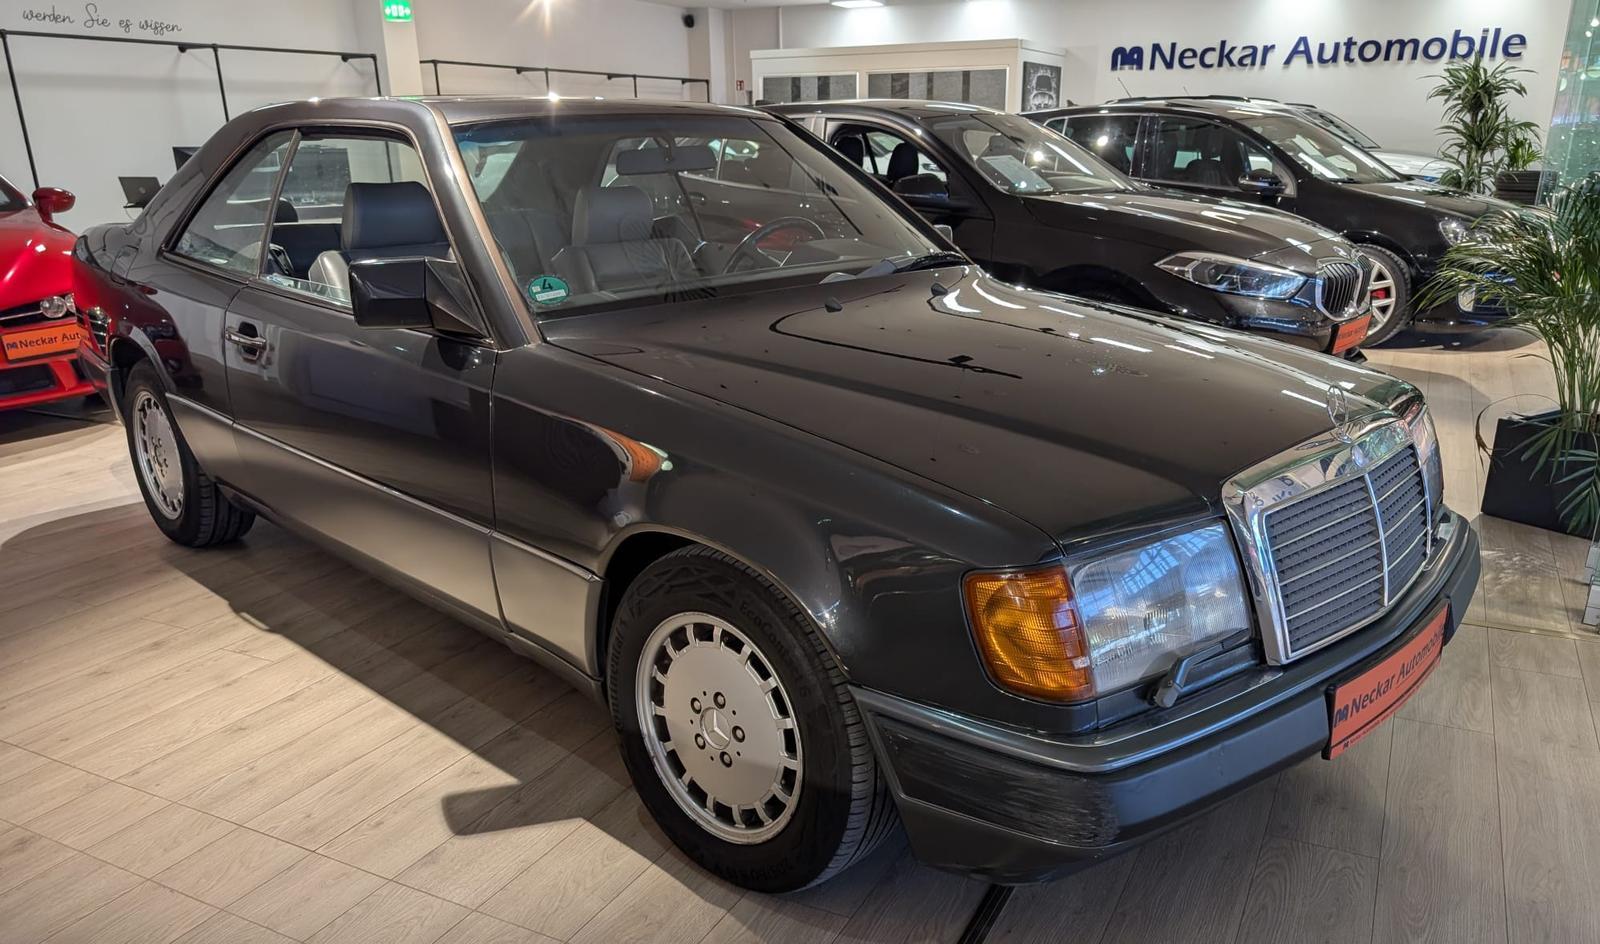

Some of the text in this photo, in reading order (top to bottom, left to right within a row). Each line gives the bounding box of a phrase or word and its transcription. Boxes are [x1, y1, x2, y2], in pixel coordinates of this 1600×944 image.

[22, 2, 182, 36] werden Sie es wissen
[1149, 39, 1276, 70] Neckar
[1282, 26, 1527, 67] Automobile
[542, 279, 553, 290] 4
[19, 335, 58, 349] Neckar
[1350, 674, 1395, 717] Neckar
